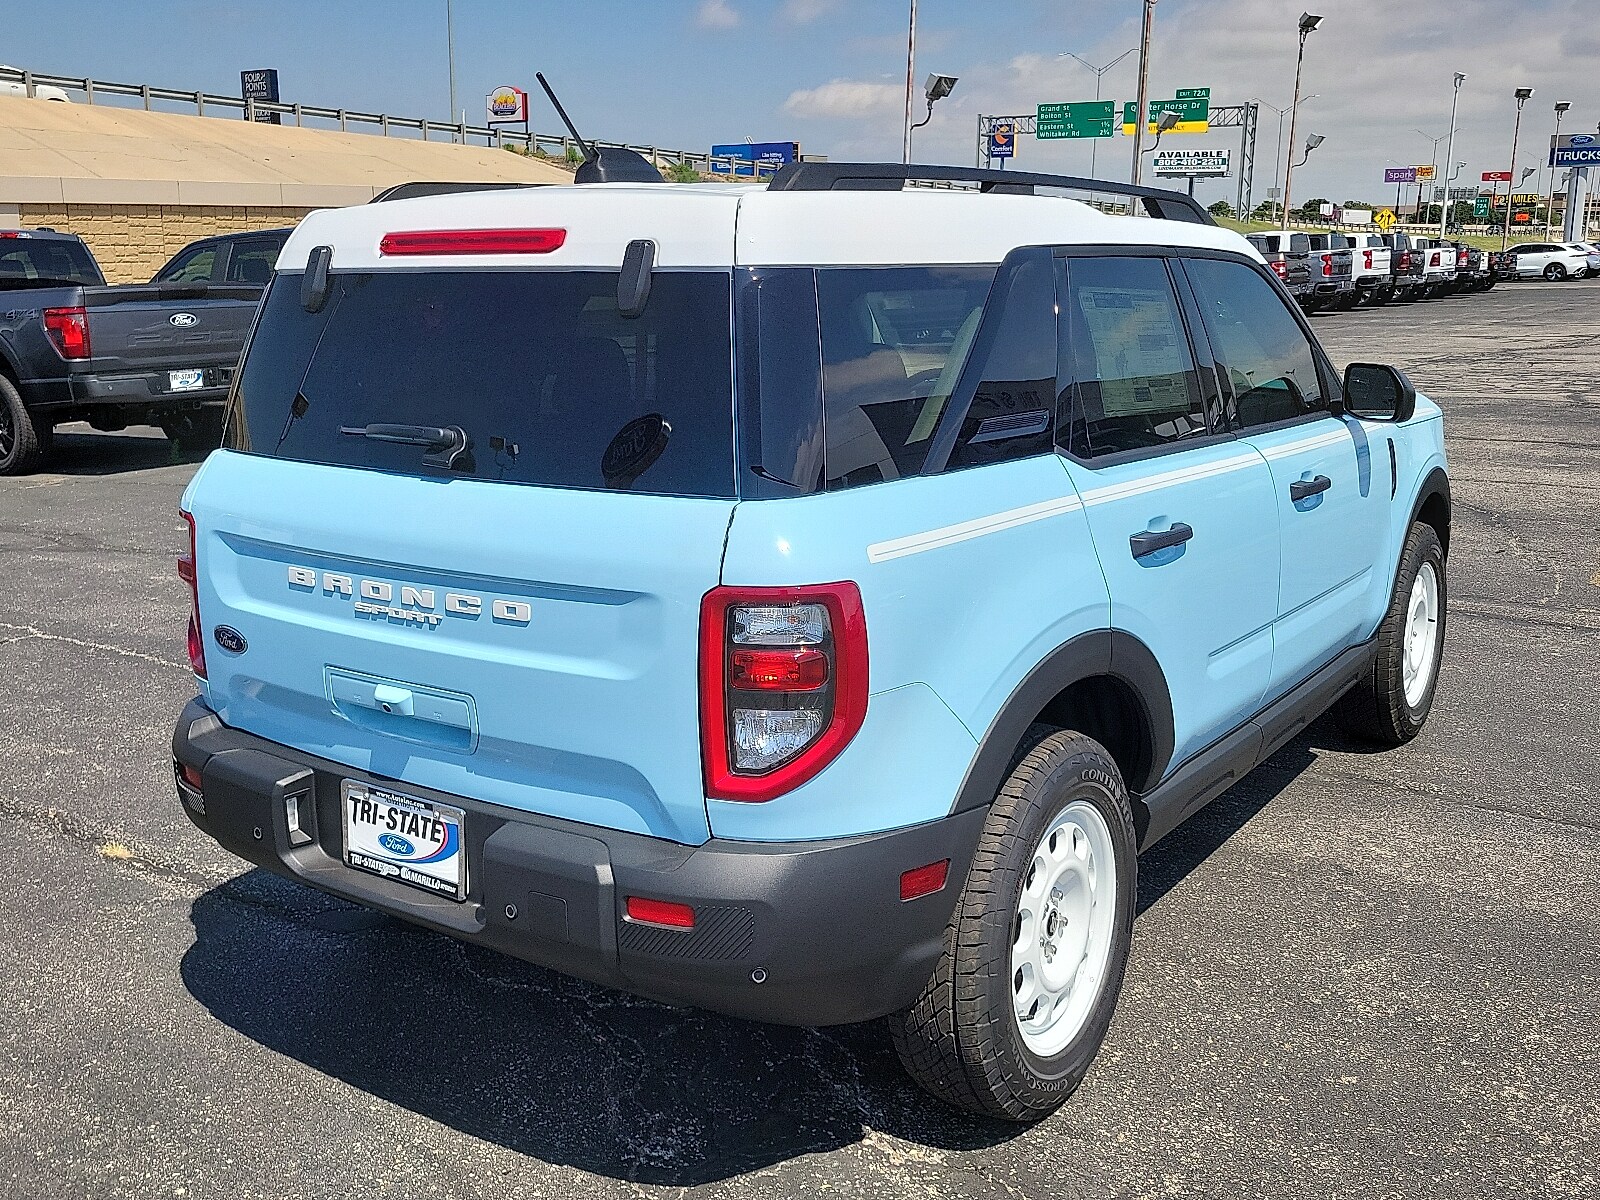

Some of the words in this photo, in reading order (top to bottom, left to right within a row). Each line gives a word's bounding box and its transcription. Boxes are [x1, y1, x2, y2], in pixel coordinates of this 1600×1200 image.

[244, 73, 261, 82] FOUR
[245, 81, 267, 91] POINTS
[1130, 103, 1161, 112] Qter
[1165, 103, 1188, 111] Horse
[1158, 158, 1223, 166] 806-410-2211
[1388, 170, 1414, 180] spark
[1512, 194, 1538, 204] MILES
[287, 565, 532, 623] BRONCO
[354, 601, 444, 626] SPORT
[349, 795, 442, 844] TRI-STATE
[385, 834, 409, 854] Ford
[350, 853, 383, 872] TRI-STATE
[406, 869, 441, 890] AMARILLO
